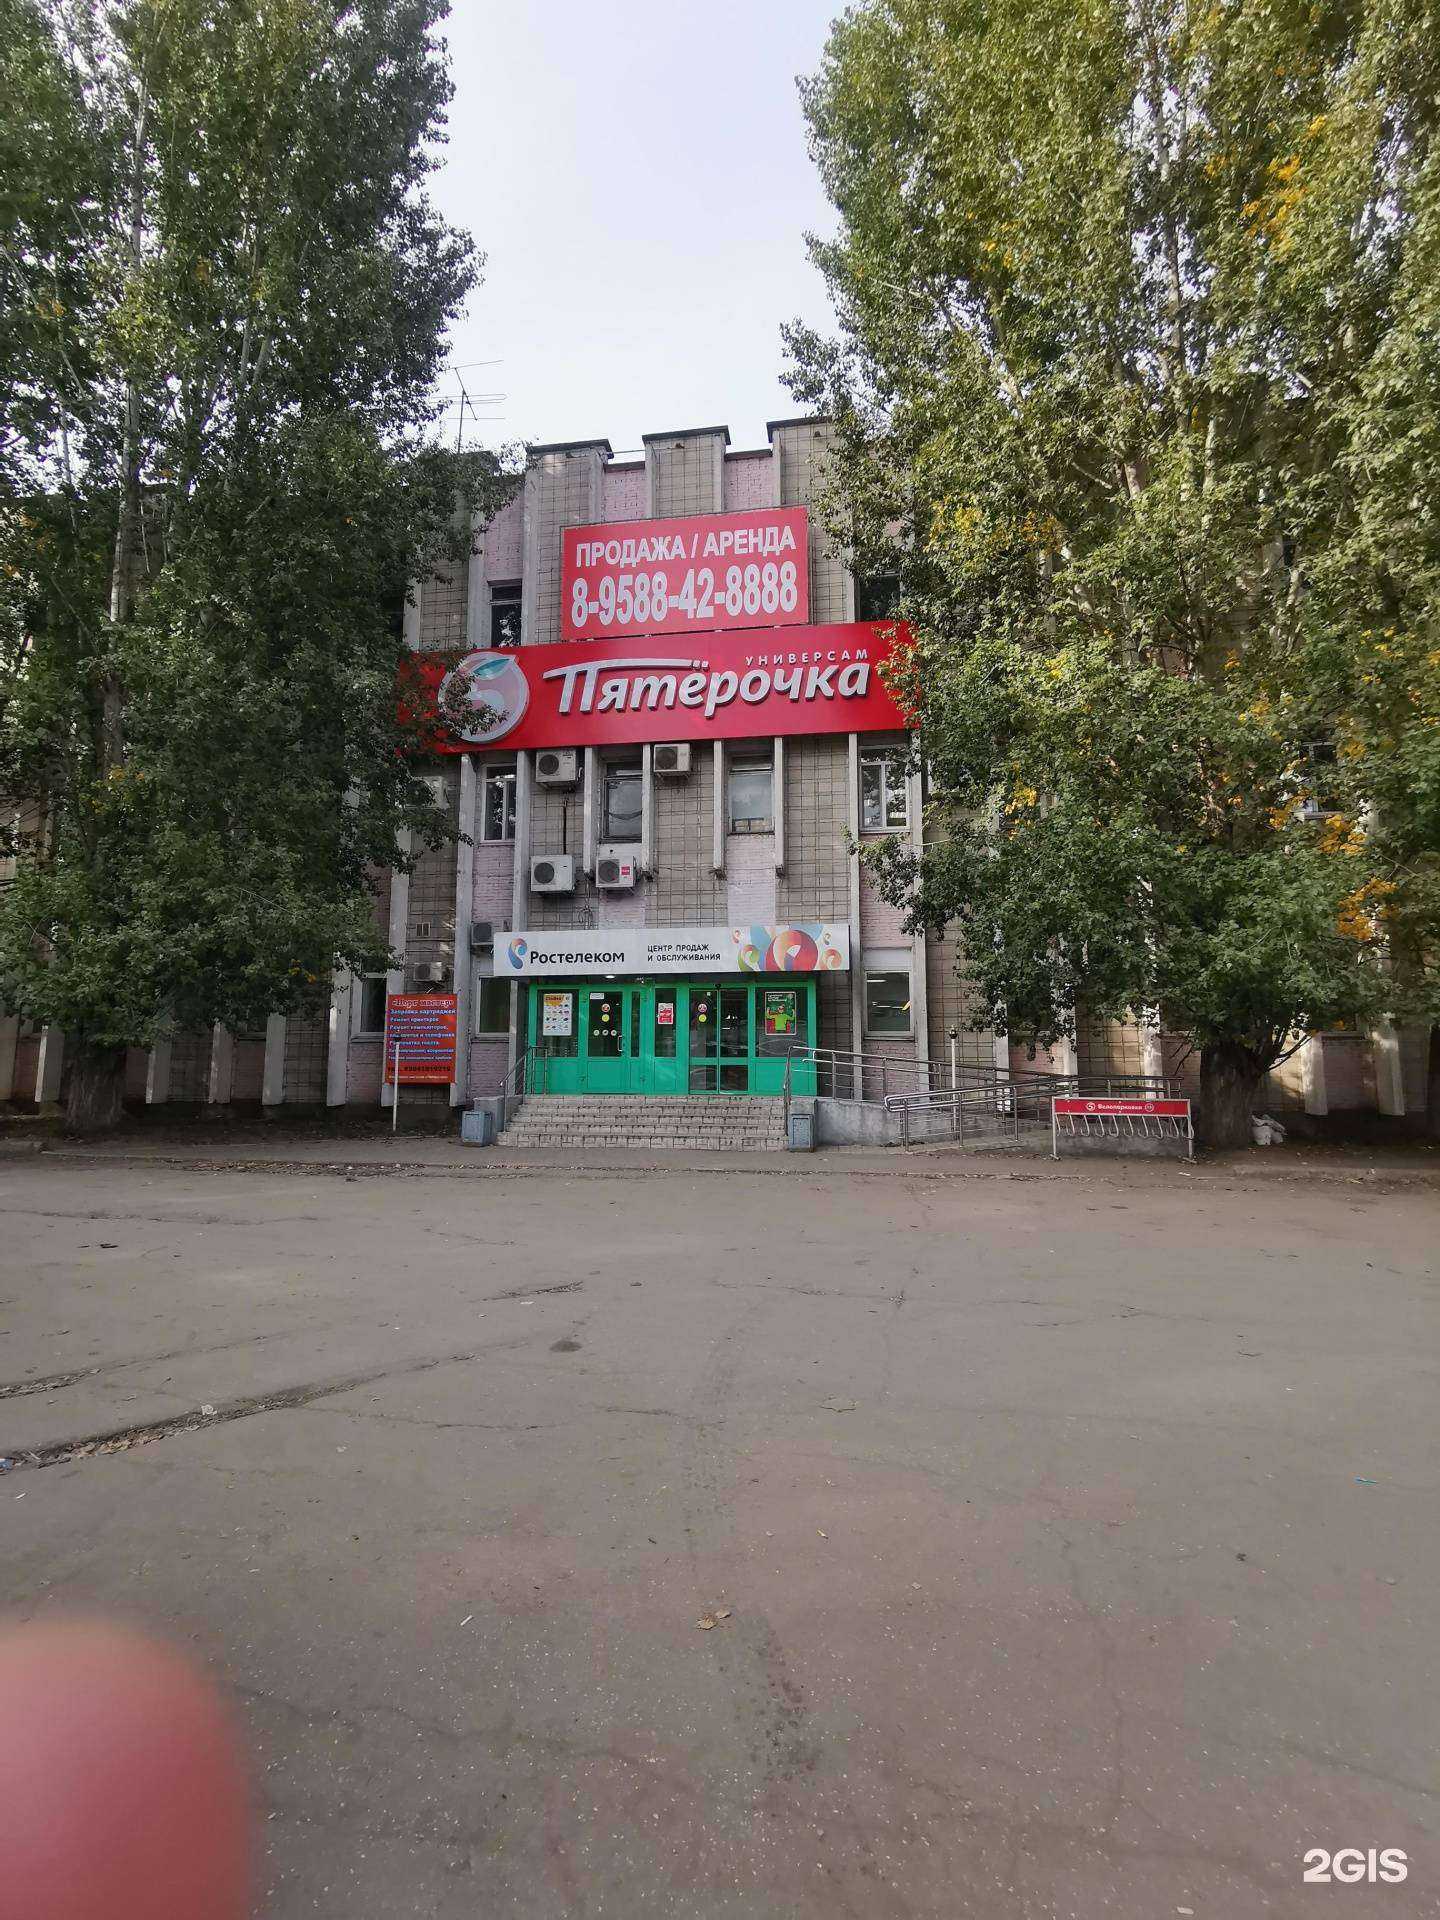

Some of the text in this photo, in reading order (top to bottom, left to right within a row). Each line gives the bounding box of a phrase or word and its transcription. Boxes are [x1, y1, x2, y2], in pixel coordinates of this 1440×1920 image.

[576, 535, 686, 567] ПРОДАЖА
[703, 525, 797, 557] АРЕНДА
[572, 561, 798, 627] 8-9588-42-8888
[746, 648, 868, 666] УНИВЕРСАМ
[543, 657, 871, 718] Пятёрочка
[530, 950, 625, 965] Ростелеком
[648, 944, 710, 953] ЦЕНТР ПРОДАЖ
[656, 953, 721, 961] ОБСЛУЖИВАНИЯ
